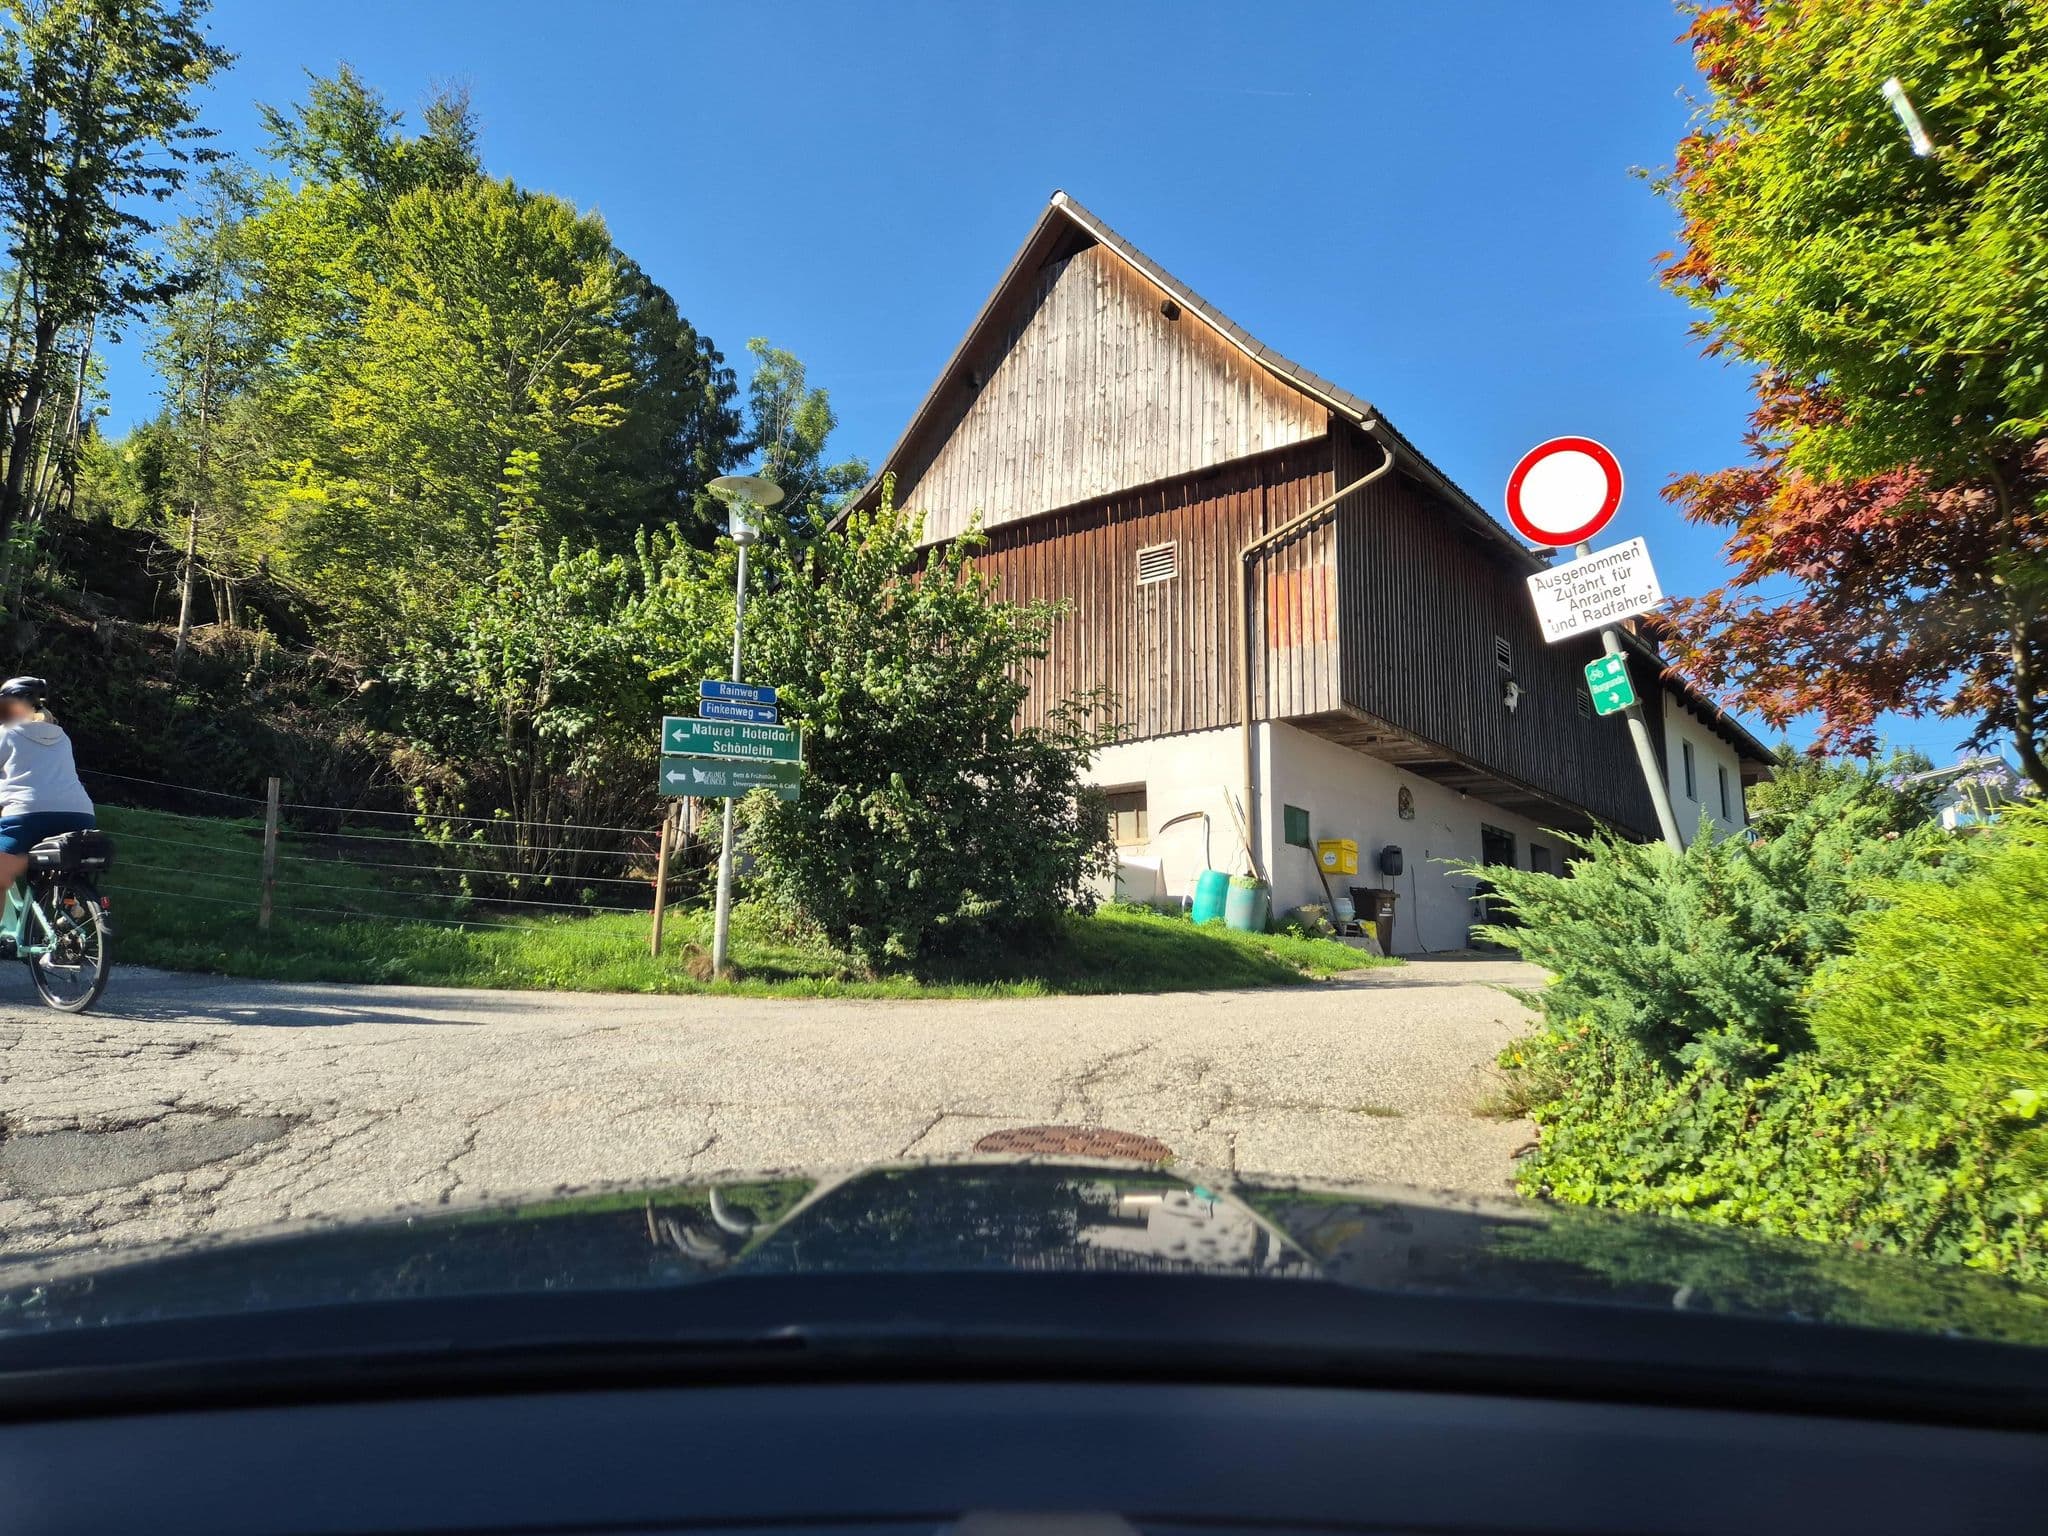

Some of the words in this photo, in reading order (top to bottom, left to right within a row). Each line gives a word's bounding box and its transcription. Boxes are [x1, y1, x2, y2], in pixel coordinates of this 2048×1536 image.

[1535, 547, 1640, 592] Ausgenommen
[1554, 575, 1606, 602] Zufahrt
[1612, 567, 1632, 581] für
[1570, 584, 1626, 611] Anrainer
[1551, 615, 1577, 633] und
[1582, 591, 1653, 622] Radfahrer
[719, 684, 759, 698] Rainweg
[706, 703, 754, 719] Finkenweg
[692, 723, 734, 737] Naturel
[742, 727, 795, 742] Hoteldorf
[713, 740, 773, 756] Schönleitn
